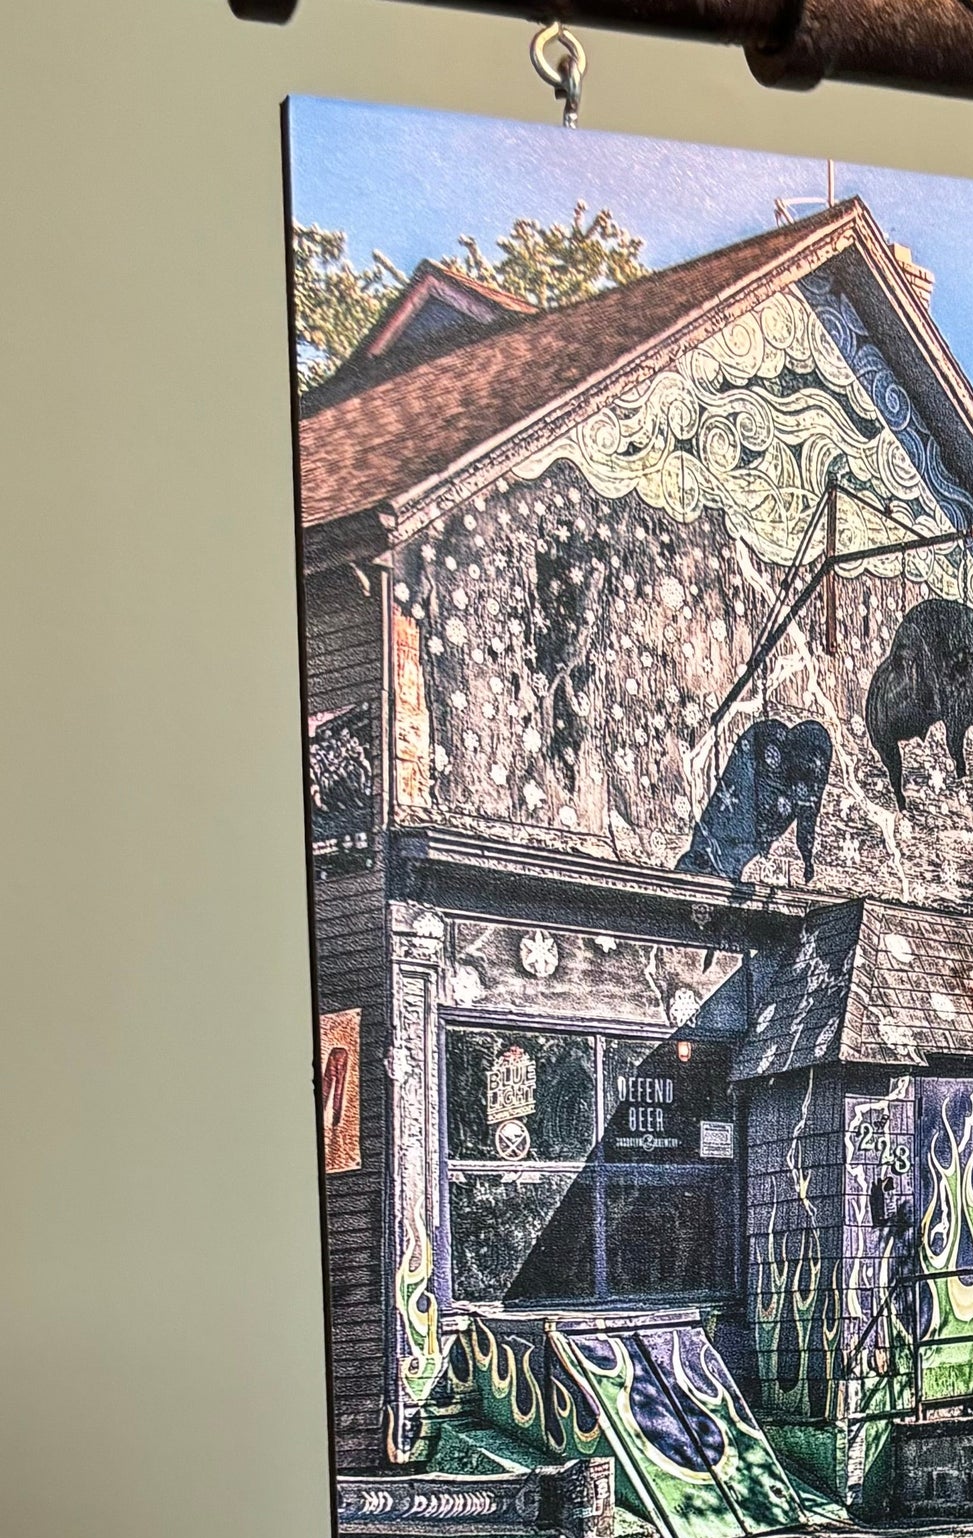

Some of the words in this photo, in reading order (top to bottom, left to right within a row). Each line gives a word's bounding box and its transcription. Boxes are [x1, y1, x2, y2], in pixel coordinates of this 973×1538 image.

[485, 1061, 537, 1093] BLUE
[617, 1076, 674, 1103] DEFEND
[487, 1085, 537, 1113] LIGHT
[629, 1107, 664, 1132] BEER
